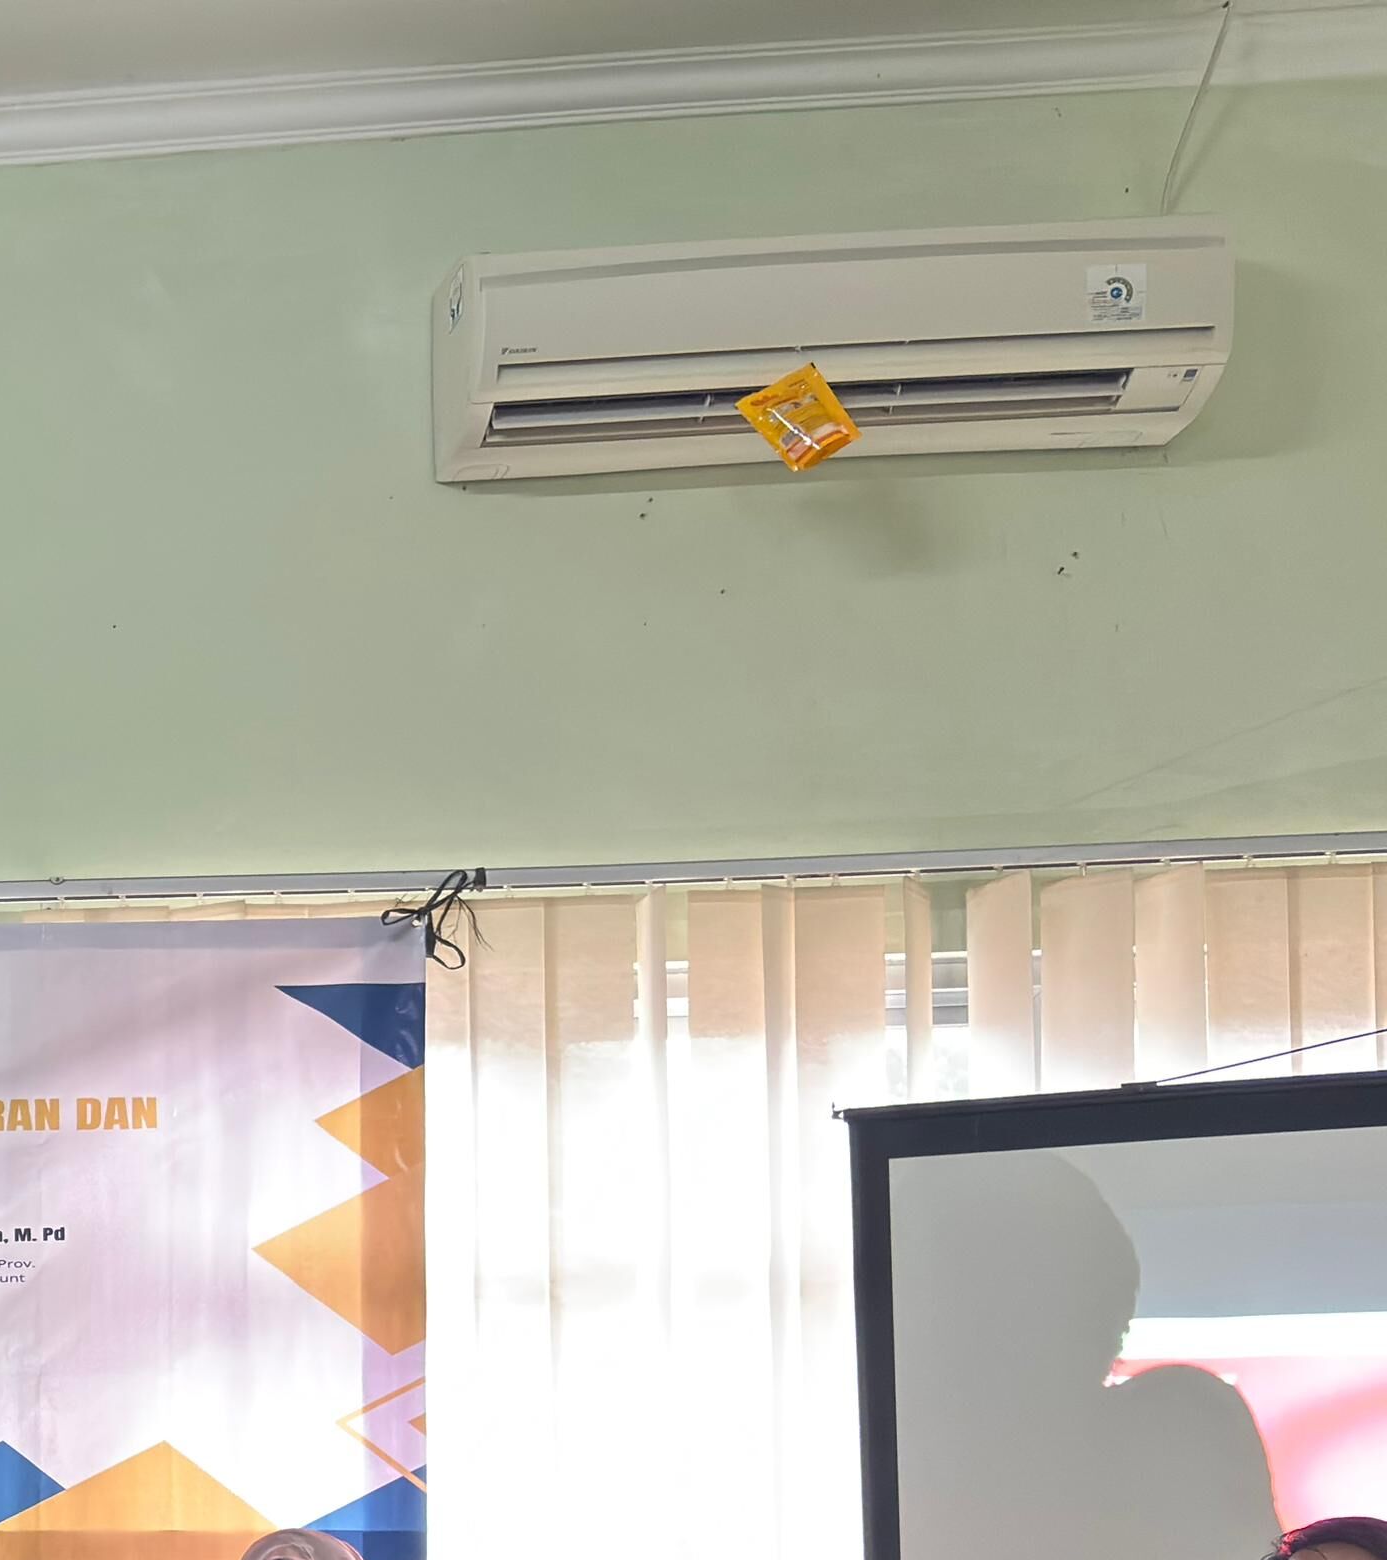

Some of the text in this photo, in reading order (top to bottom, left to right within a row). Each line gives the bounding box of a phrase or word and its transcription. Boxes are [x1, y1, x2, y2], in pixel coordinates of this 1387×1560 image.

[76, 1096, 158, 1131] DAN
[14, 1227, 38, 1242] M.
[43, 1226, 66, 1241] Pd
